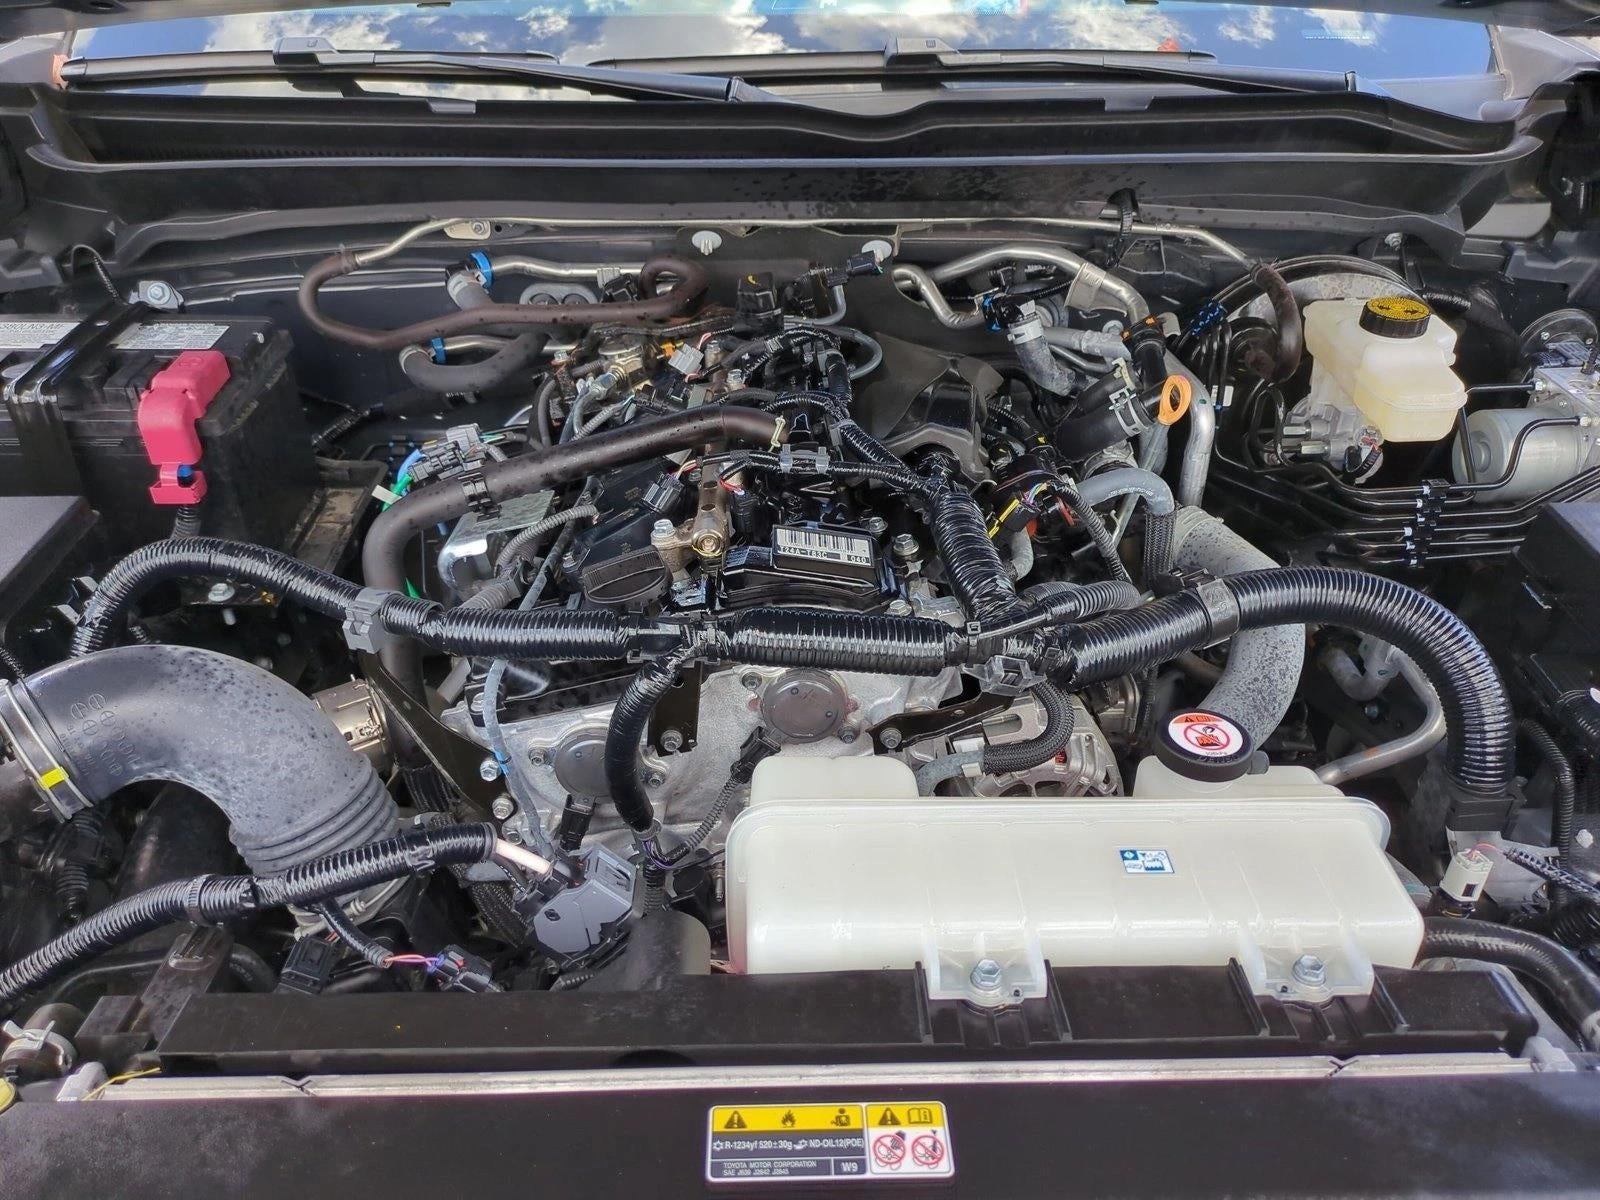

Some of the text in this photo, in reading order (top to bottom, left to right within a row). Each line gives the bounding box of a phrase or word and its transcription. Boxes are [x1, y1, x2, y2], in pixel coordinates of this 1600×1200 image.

[724, 1139, 758, 1151] R-1234yf
[809, 1138, 865, 1148] ND-OIL12(POE)
[773, 1160, 817, 1168] CORPORATION
[842, 1161, 858, 1172] W9
